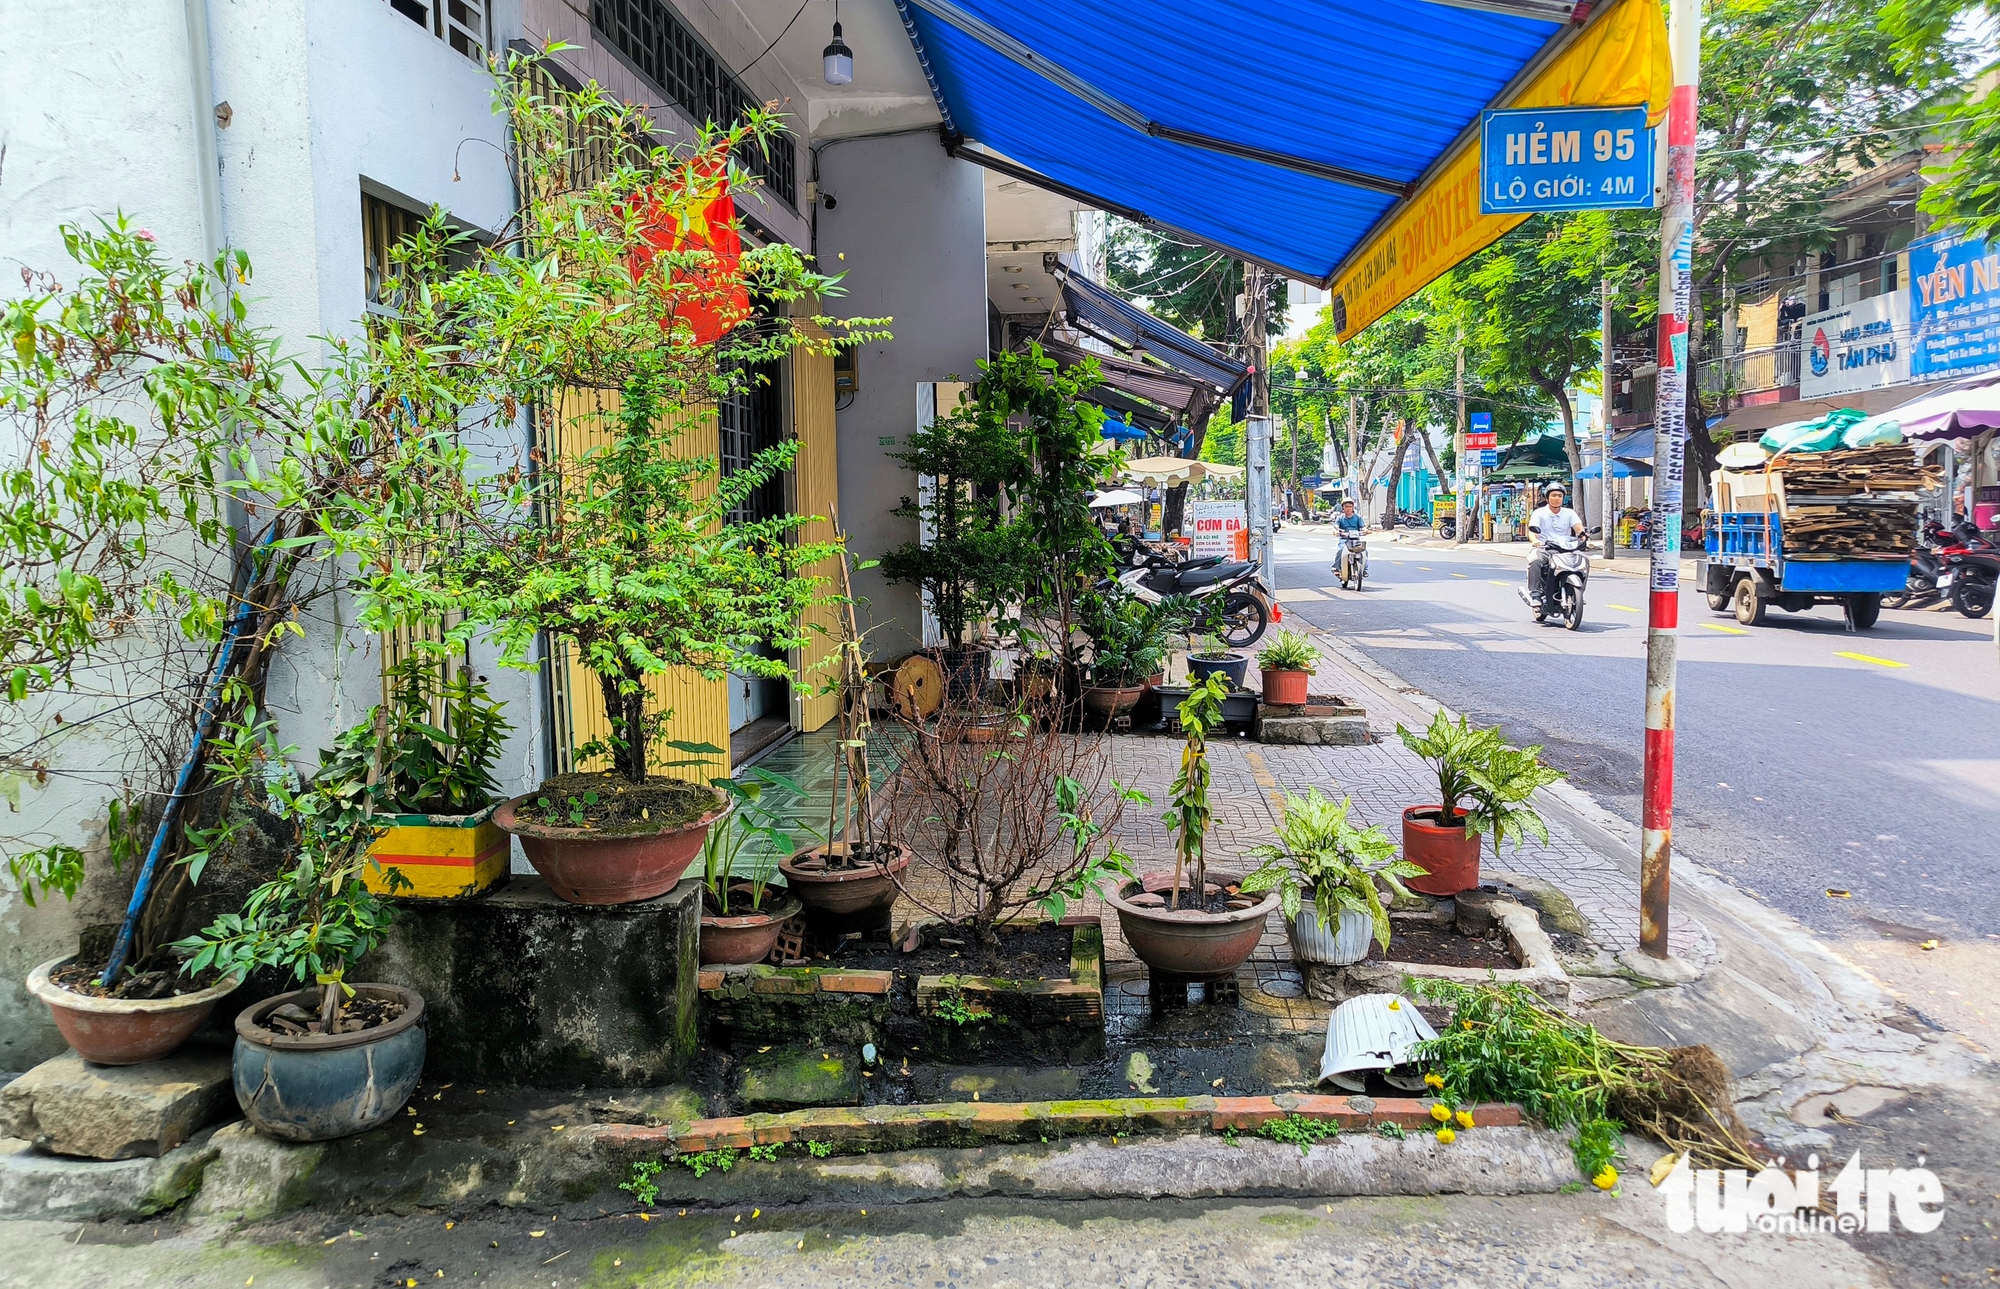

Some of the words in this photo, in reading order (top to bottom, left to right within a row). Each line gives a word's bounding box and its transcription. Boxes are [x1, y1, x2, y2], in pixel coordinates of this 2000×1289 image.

[1506, 121, 1580, 165] HẺM
[1593, 129, 1635, 162] 95
[1494, 176, 1527, 203] LỘ
[1533, 174, 1592, 198] GIỚI:
[1600, 176, 1634, 195] 4M
[1917, 252, 1966, 307] YẾN
[1837, 345, 1864, 371] TÂN
[1196, 518, 1222, 531] CƠM
[1226, 516, 1241, 531] GÀ
